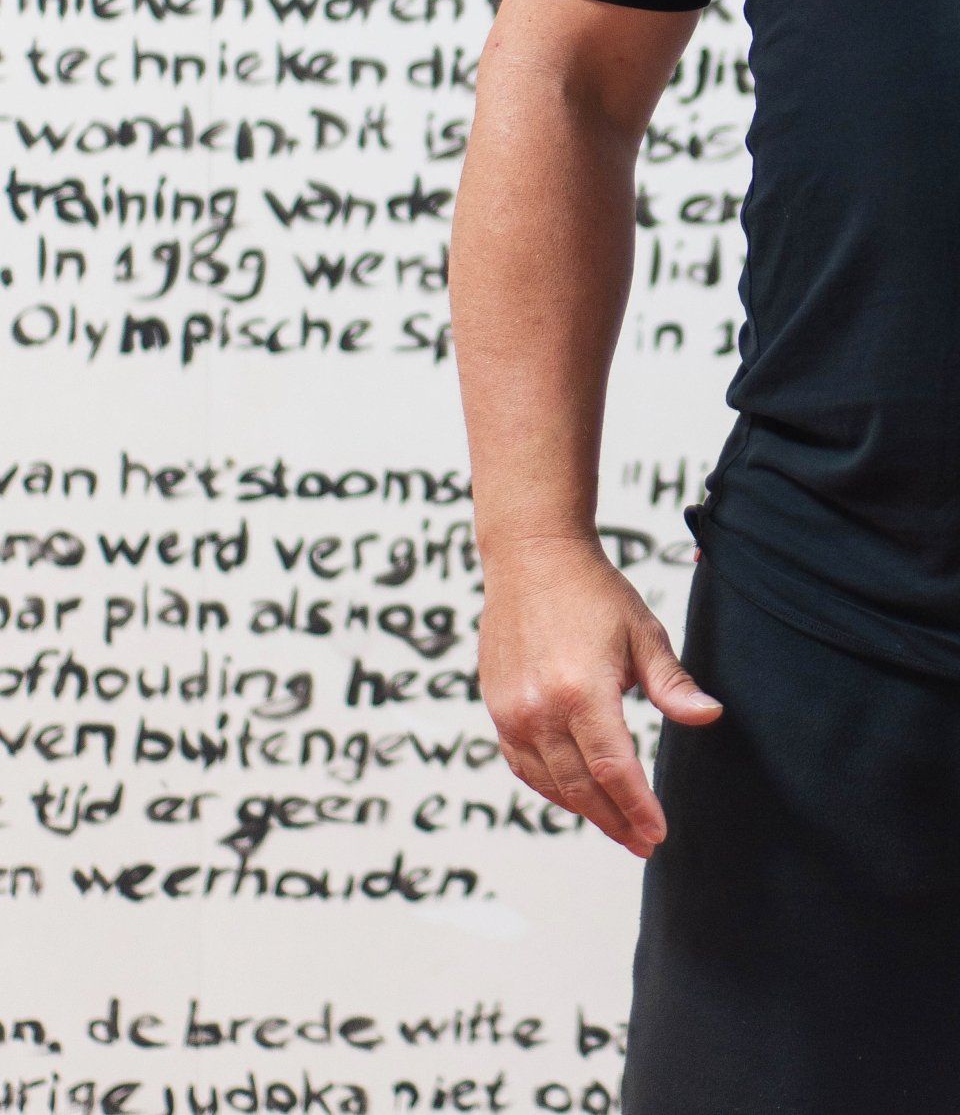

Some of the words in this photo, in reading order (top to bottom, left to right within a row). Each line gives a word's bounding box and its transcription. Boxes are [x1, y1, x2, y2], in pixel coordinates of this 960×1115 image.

[25, 40, 388, 88] technieken
[428, 114, 468, 160] is
[4, 167, 237, 230] training
[262, 180, 377, 230] van
[38, 235, 87, 282] In
[295, 240, 448, 292] werd
[648, 236, 722, 289] lid
[10, 303, 372, 368] Olympische
[635, 310, 685, 351] in
[97, 518, 250, 575] werd
[103, 583, 230, 647] plan
[248, 587, 335, 639] als
[143, 792, 217, 826] er
[86, 997, 169, 1050] de
[183, 998, 385, 1053] brede
[397, 1001, 547, 1052] witte
[391, 1071, 509, 1115] niet
